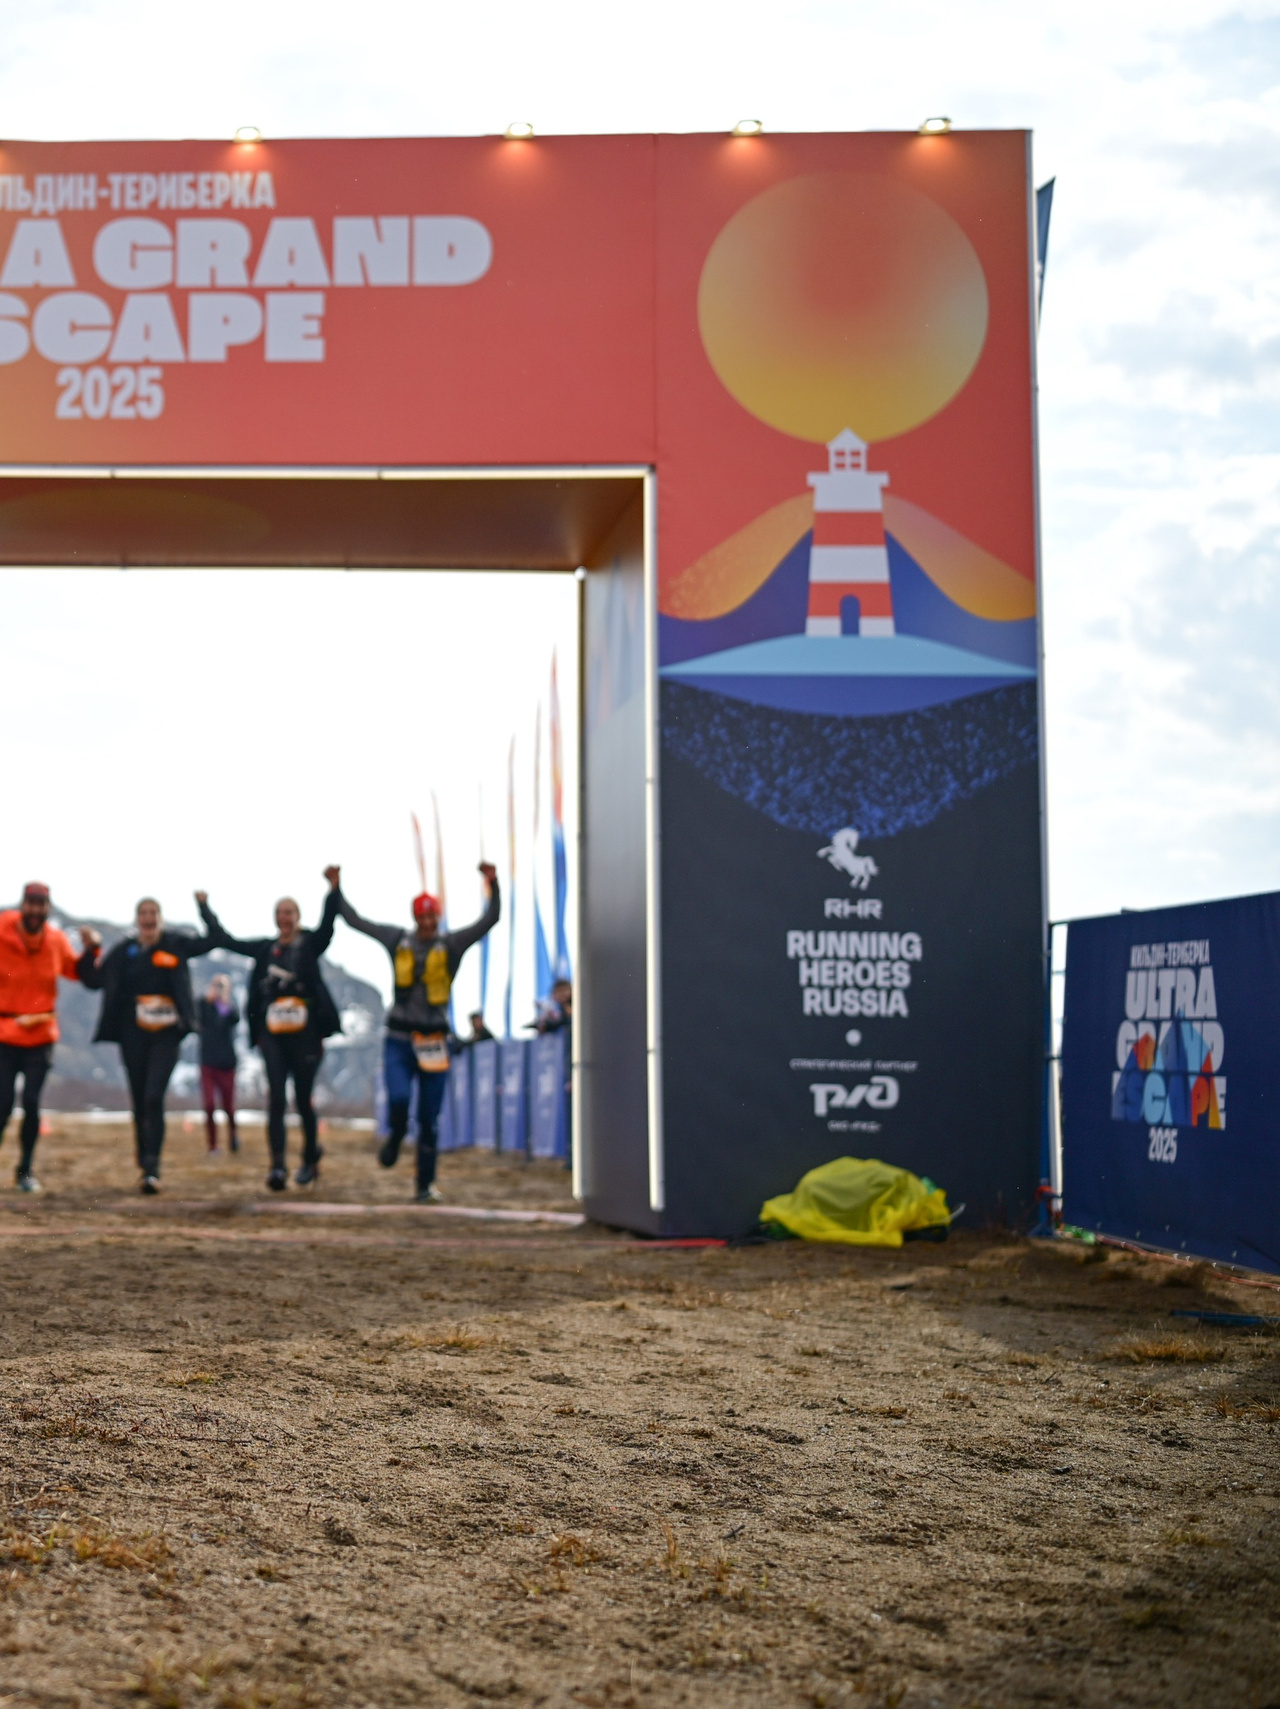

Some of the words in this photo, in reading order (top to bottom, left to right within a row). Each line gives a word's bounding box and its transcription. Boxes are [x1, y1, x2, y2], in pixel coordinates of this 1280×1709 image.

[93, 215, 493, 289] GRAND
[56, 366, 165, 420] 2025
[824, 898, 883, 920] RHR
[786, 930, 923, 961] RUNNING
[798, 959, 912, 988] HEROES
[1124, 966, 1218, 1020] ULTRA
[802, 987, 909, 1018] RUSSIA
[1116, 1020, 1225, 1075] GRAND
[1111, 1071, 1228, 1131] ESCAPE
[1148, 1127, 1179, 1164] 2025
